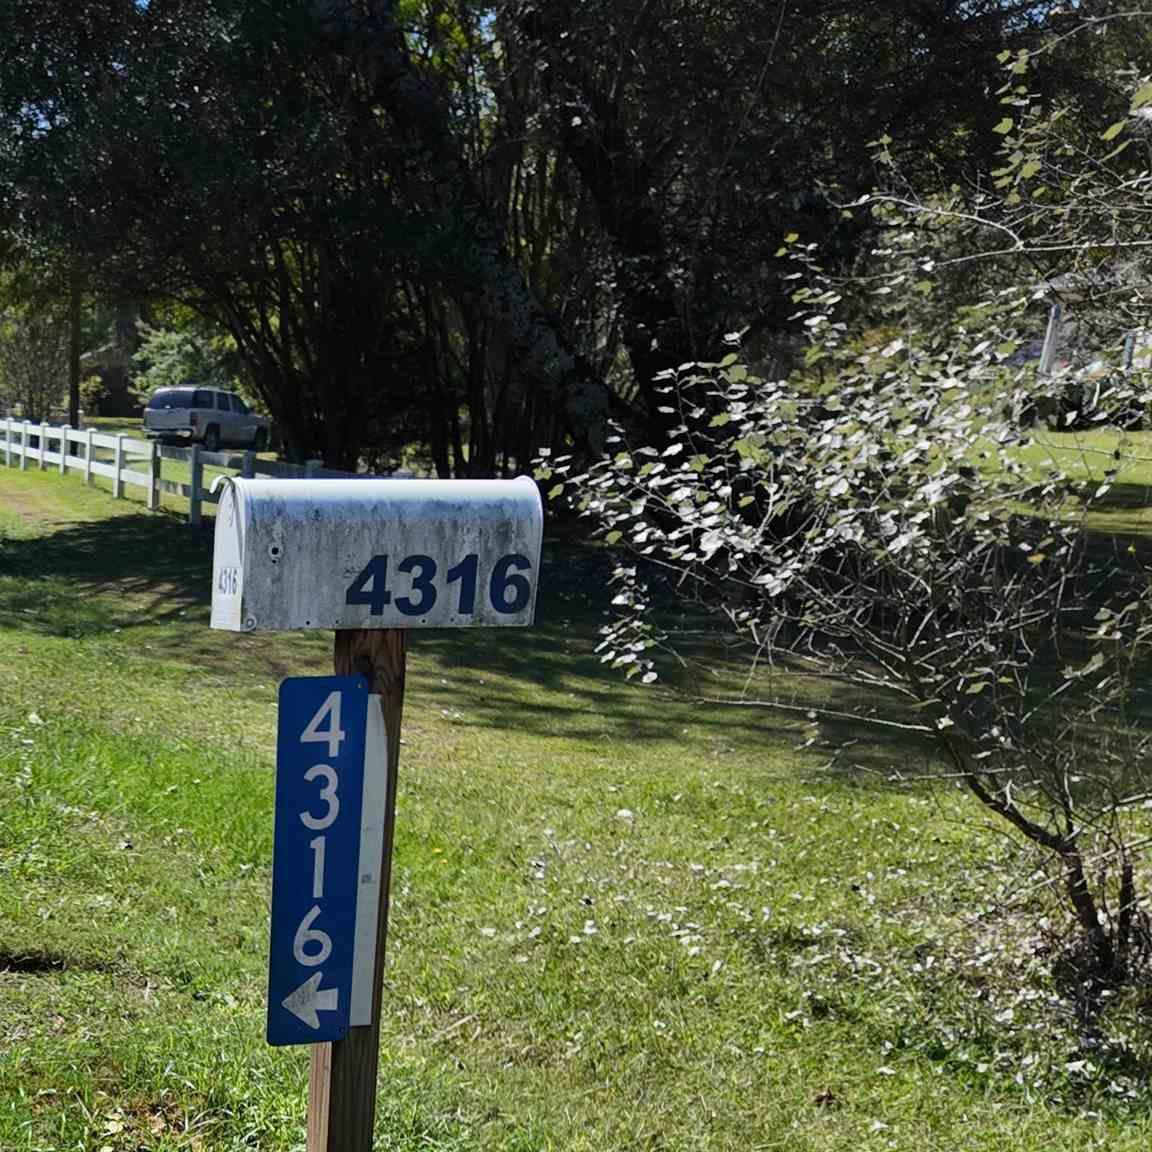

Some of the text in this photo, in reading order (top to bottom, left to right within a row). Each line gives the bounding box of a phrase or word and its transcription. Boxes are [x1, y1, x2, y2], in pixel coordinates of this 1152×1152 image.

[218, 568, 238, 595] 4316
[345, 553, 532, 617] 4316
[293, 690, 345, 967] 4316
